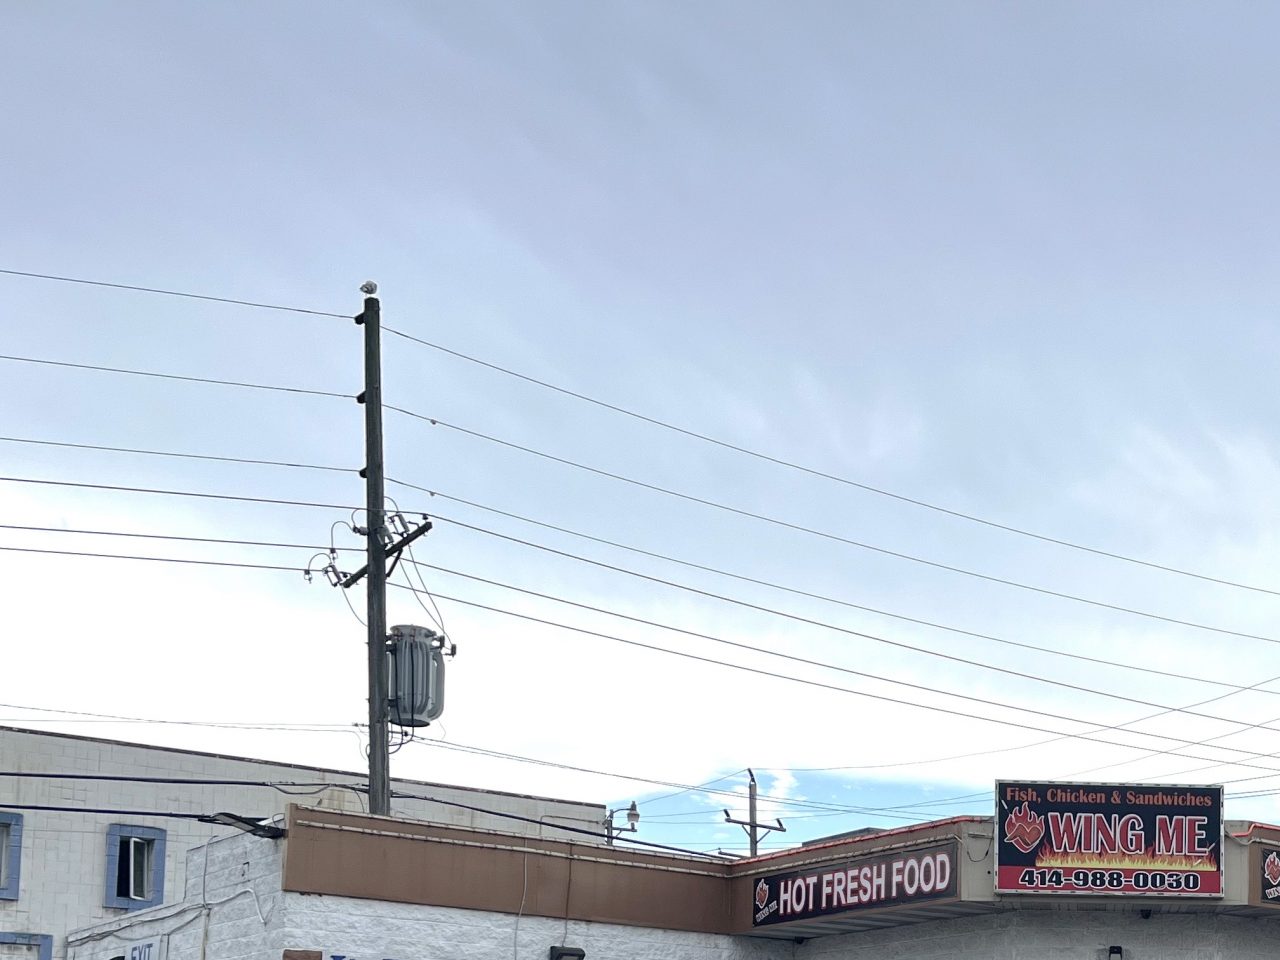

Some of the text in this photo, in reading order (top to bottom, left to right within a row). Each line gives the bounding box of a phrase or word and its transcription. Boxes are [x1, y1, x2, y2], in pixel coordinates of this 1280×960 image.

[1006, 787, 1213, 807] Fish, Chicken & Sandwiches
[1048, 812, 1209, 856] WING ME
[779, 853, 950, 914] HOT FRESH FOOD
[1019, 869, 1201, 891] 414-988-0030
